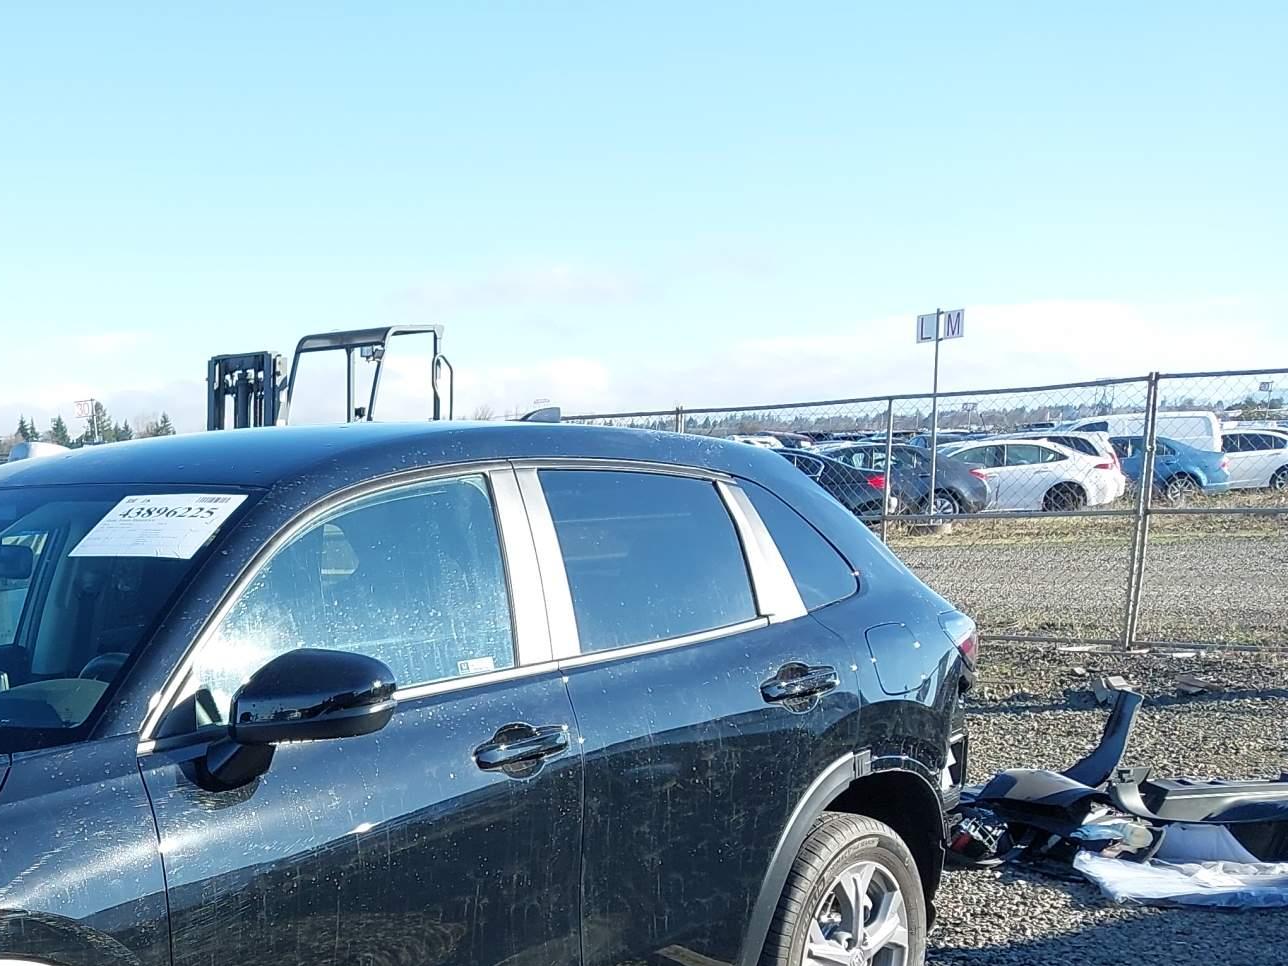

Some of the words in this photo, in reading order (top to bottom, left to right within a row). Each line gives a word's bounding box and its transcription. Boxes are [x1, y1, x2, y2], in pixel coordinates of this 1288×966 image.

[921, 318, 931, 340] L
[947, 312, 960, 336] M
[118, 506, 219, 519] 43896225
